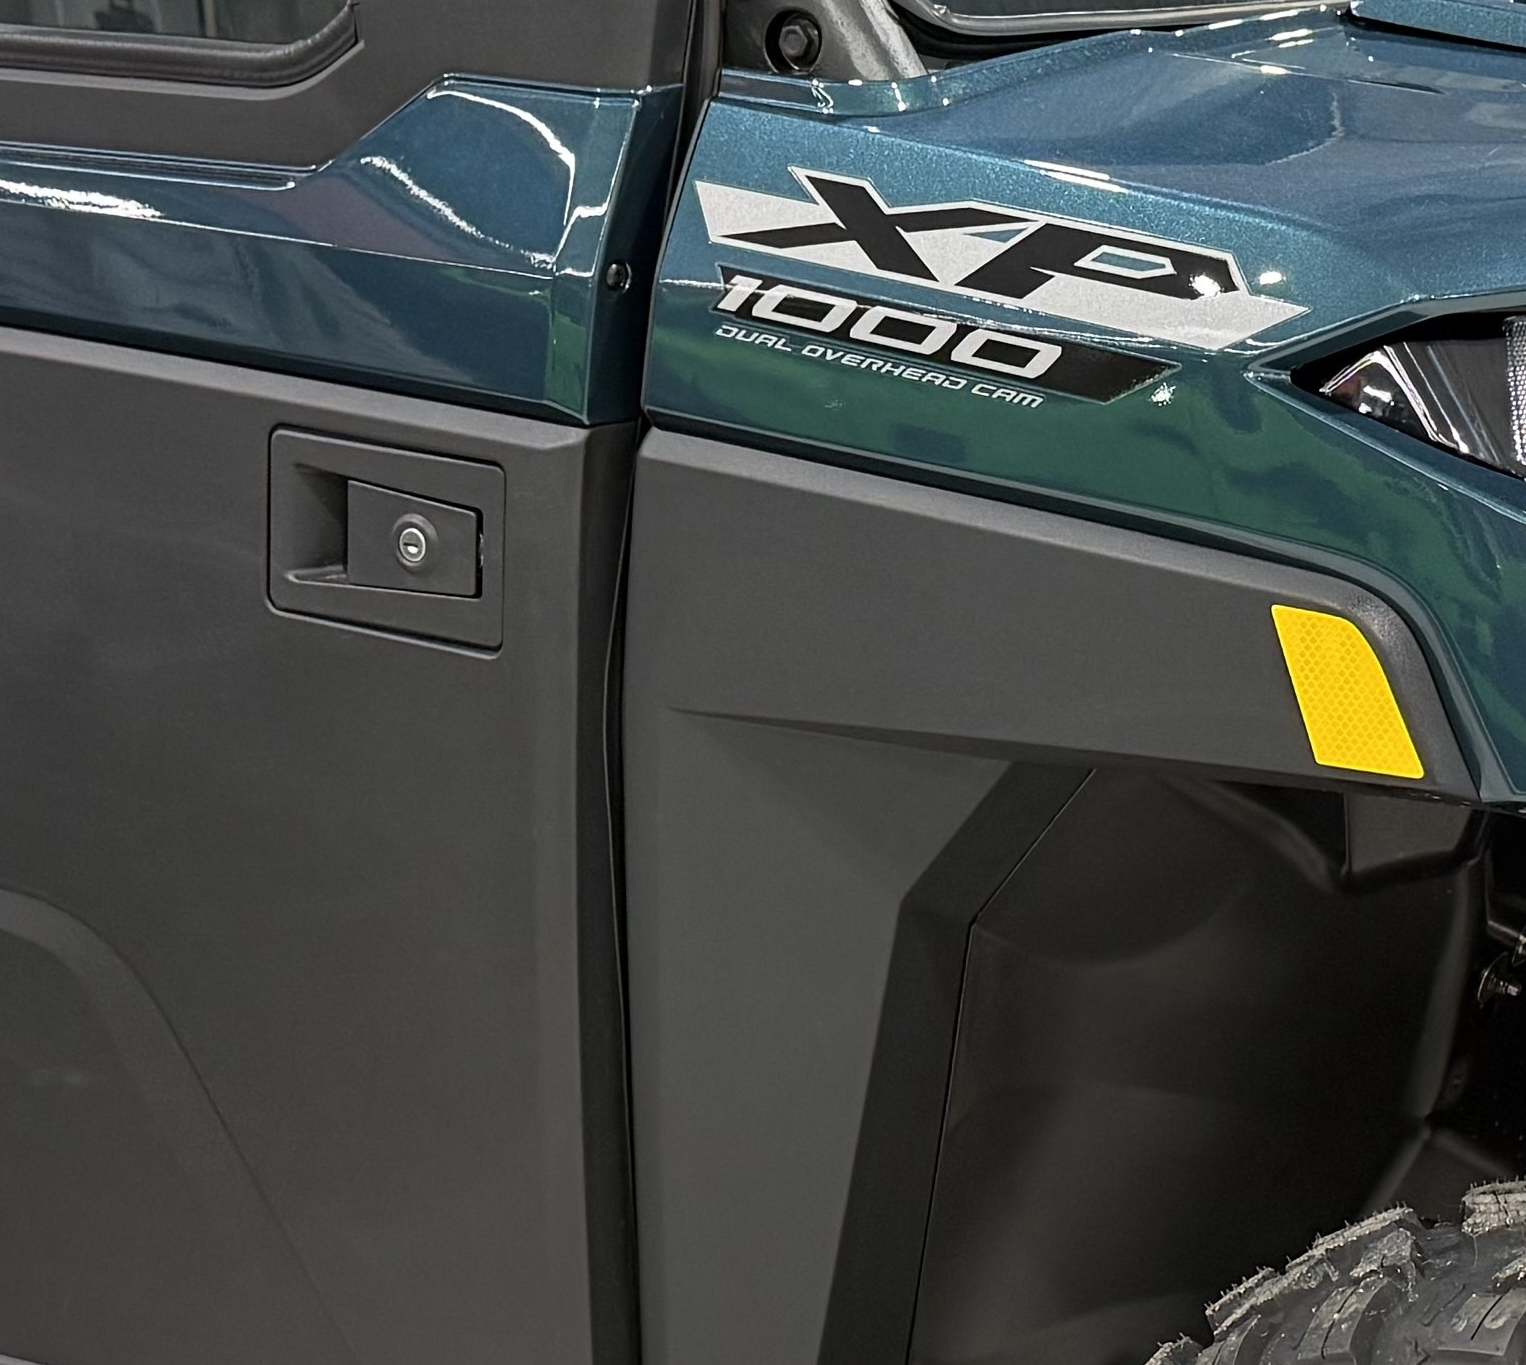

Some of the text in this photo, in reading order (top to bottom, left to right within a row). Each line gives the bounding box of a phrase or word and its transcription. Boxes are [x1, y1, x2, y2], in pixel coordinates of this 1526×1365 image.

[720, 166, 1248, 304] XP
[714, 273, 1063, 381] 1000
[715, 325, 1045, 409] DUAL OVERHEAD CAM
